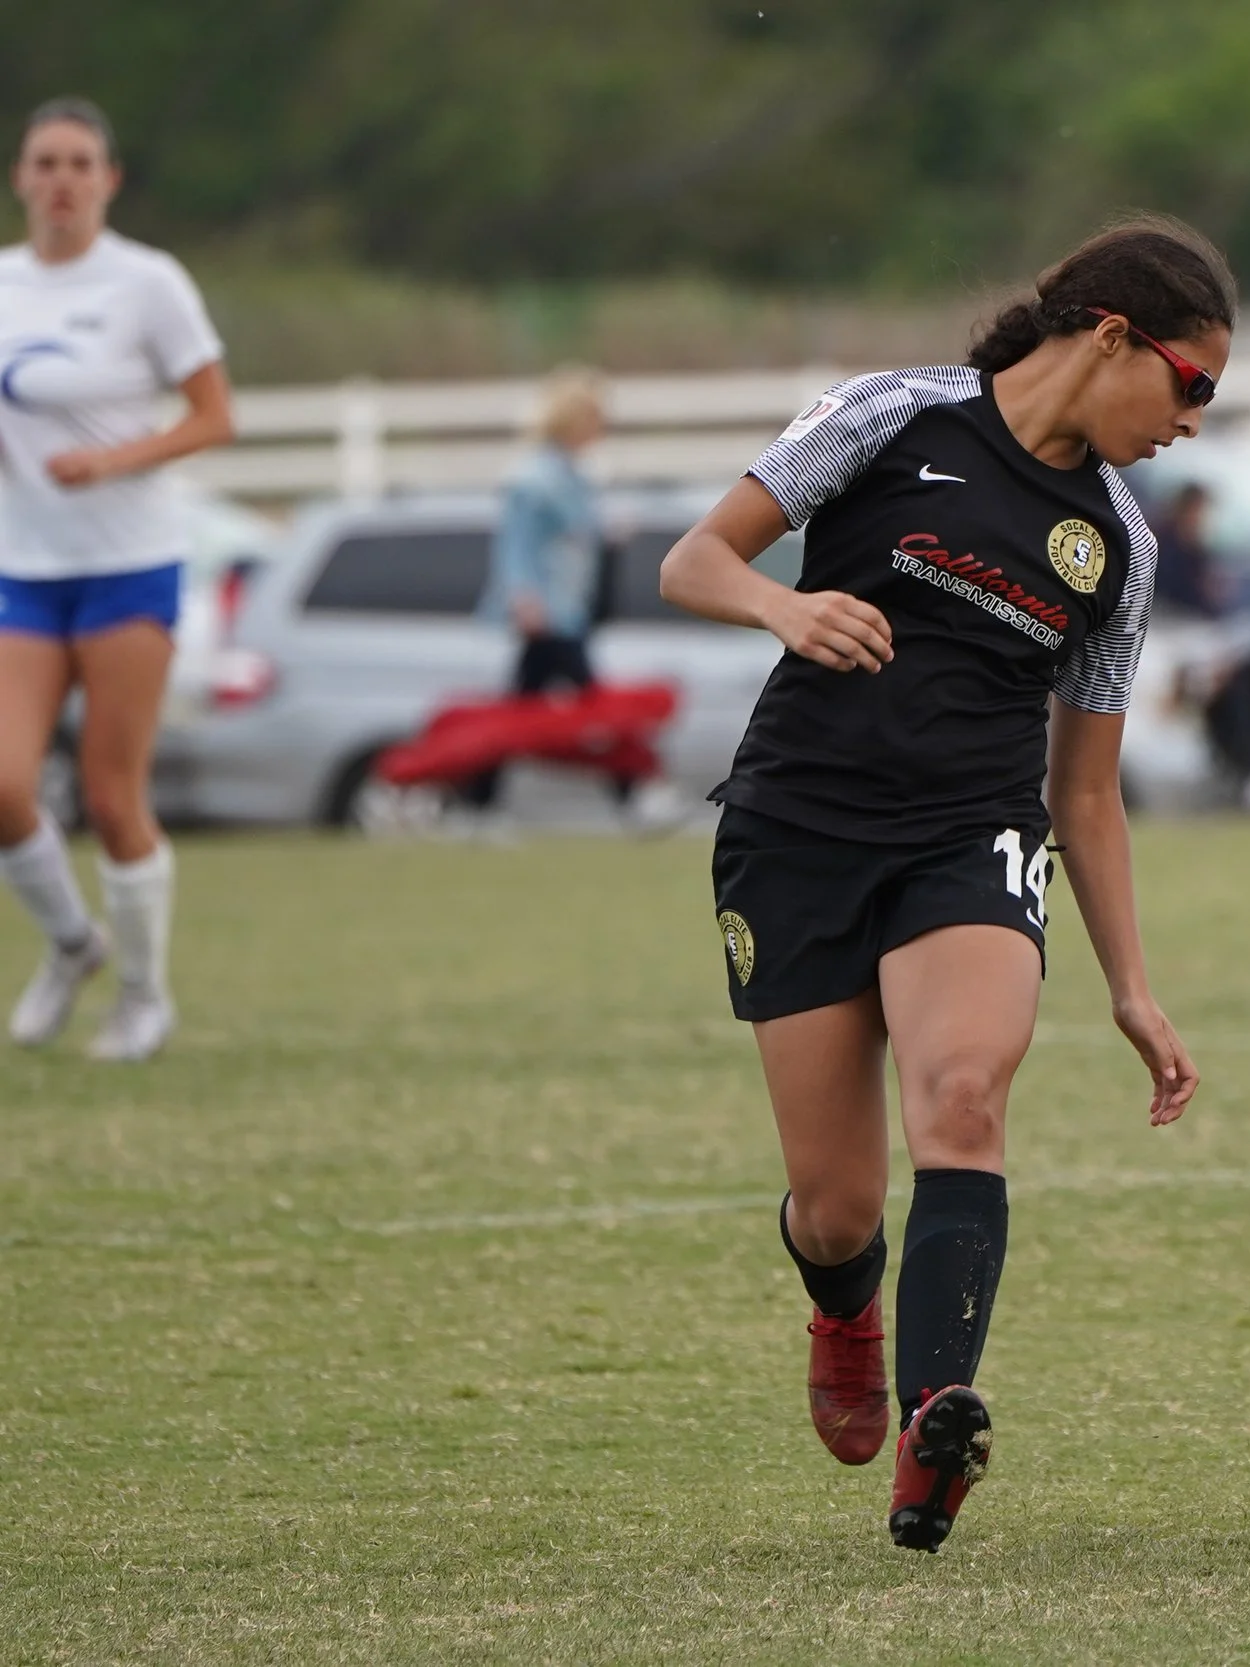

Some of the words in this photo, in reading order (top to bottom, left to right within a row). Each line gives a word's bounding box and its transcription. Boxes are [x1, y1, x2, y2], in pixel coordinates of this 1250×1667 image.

[1050, 545, 1082, 590] FOOTBALL
[1060, 521, 1089, 534] SOCAL
[1091, 531, 1104, 559] ELITE
[890, 549, 1065, 651] TRANSMISSION
[899, 532, 1069, 632] California
